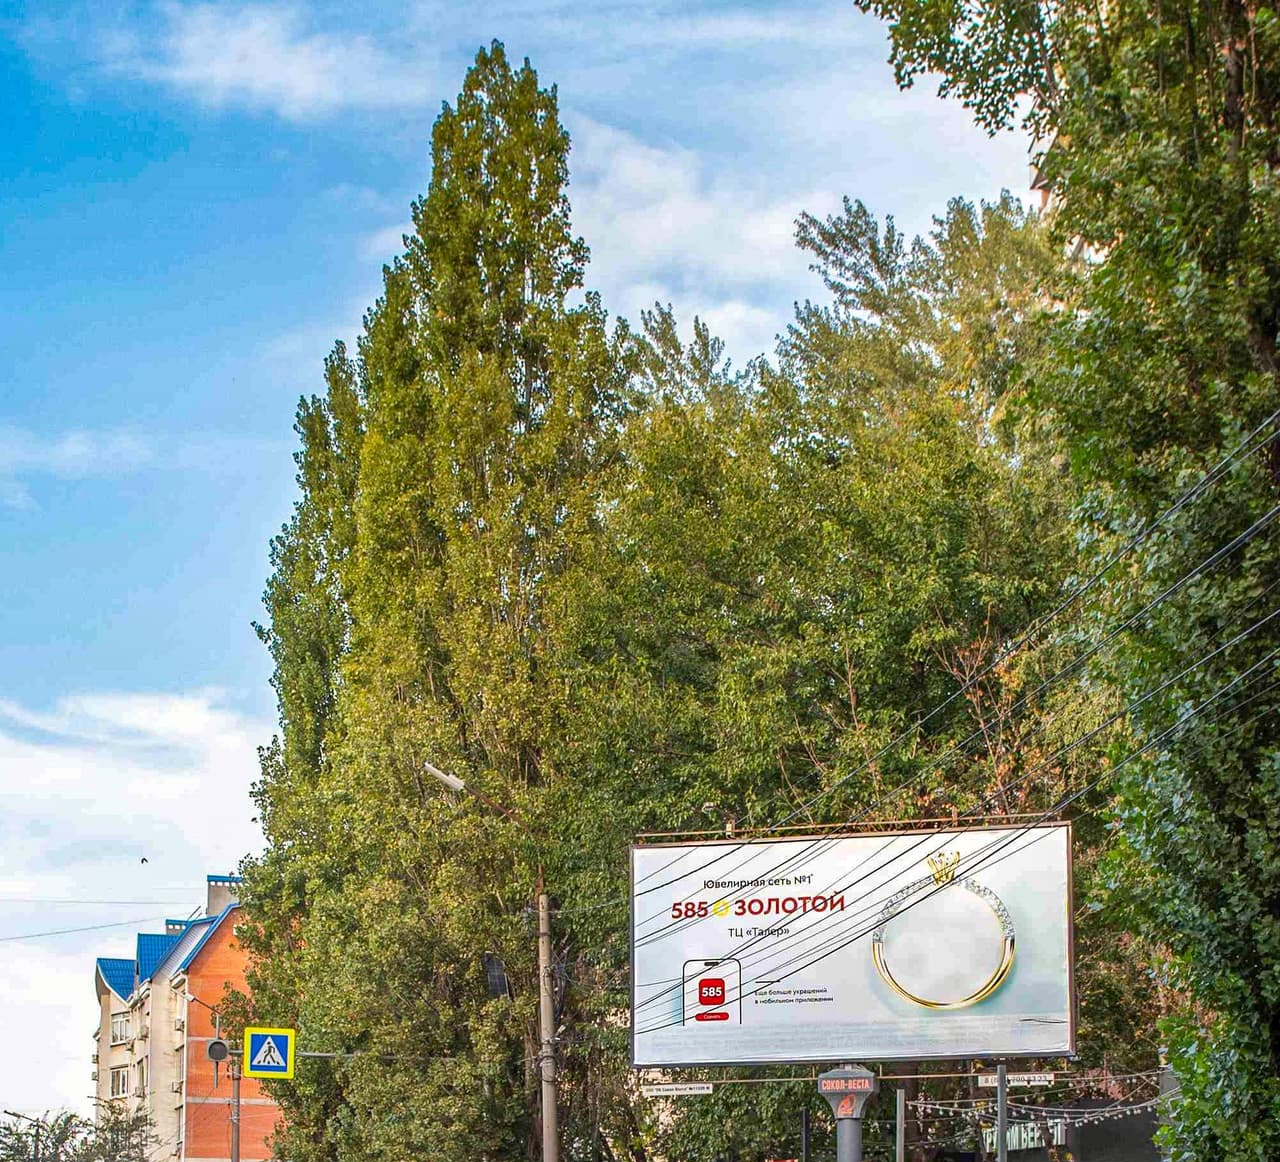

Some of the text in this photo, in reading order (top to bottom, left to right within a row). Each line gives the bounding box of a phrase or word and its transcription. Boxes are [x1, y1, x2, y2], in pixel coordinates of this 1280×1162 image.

[703, 879, 765, 892] Ювелирная
[768, 878, 791, 887] сеть
[671, 890, 846, 919] 585 ЗОЛОТОЙ
[728, 928, 743, 938] ТЦ
[701, 987, 723, 998] 585
[821, 1078, 870, 1090] СОКОЛ-ВЕСТА
